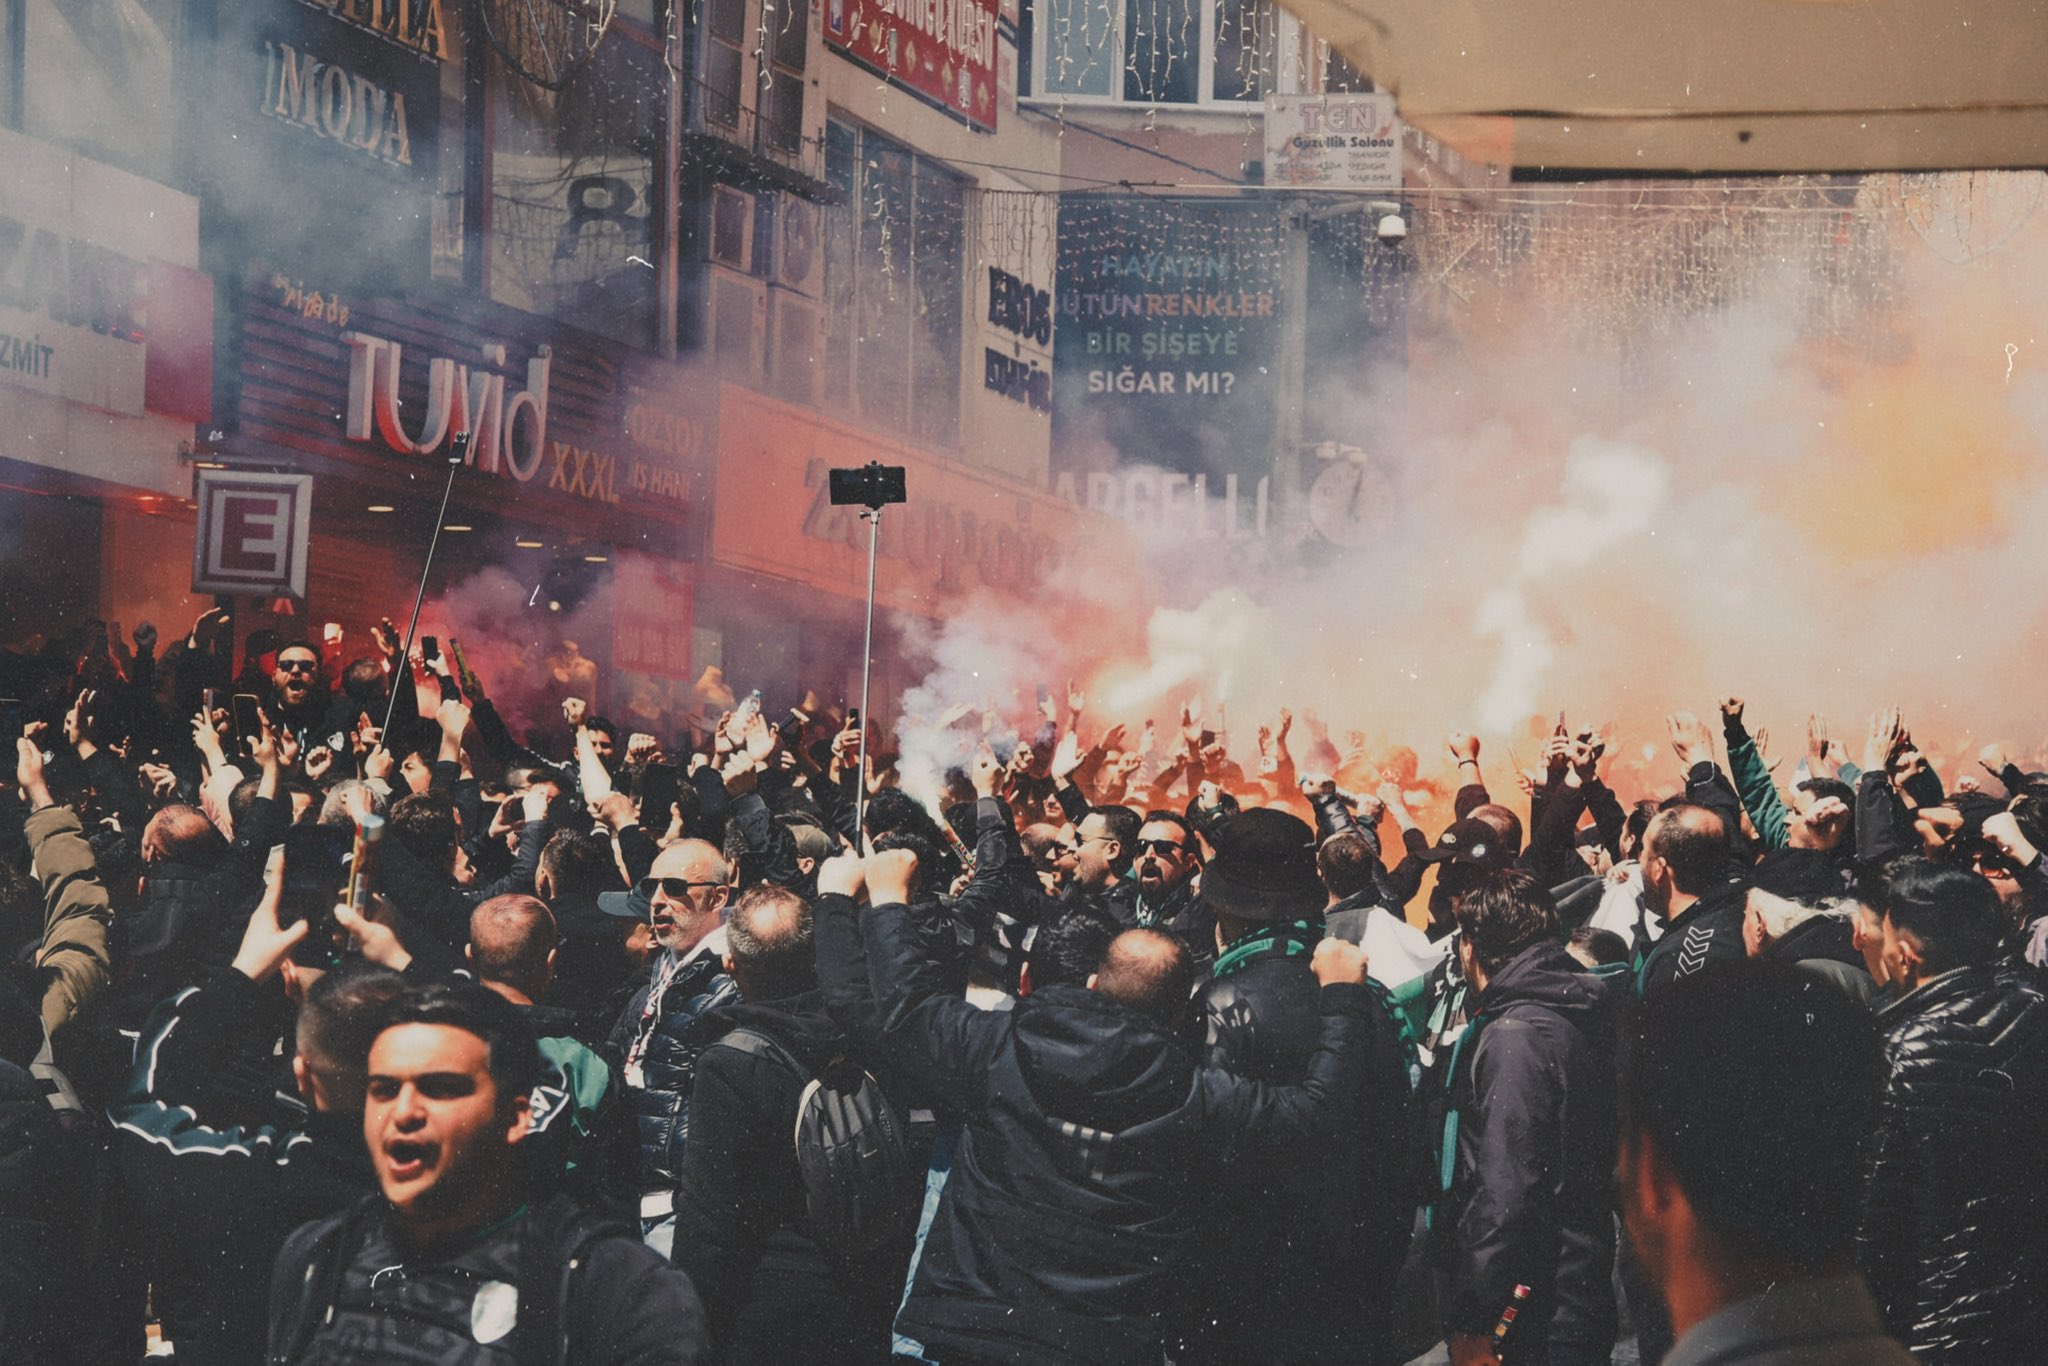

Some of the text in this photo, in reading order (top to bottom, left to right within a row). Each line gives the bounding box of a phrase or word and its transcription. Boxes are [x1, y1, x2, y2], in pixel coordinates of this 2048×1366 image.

[1350, 136, 1395, 148] Salonu
[1055, 288, 1274, 317] ÜTÜN RENKLER
[1086, 326, 1239, 361] BİR ŞİŞEYE
[1087, 365, 1236, 394] SIĞAR MI?
[549, 441, 620, 503] XXXL
